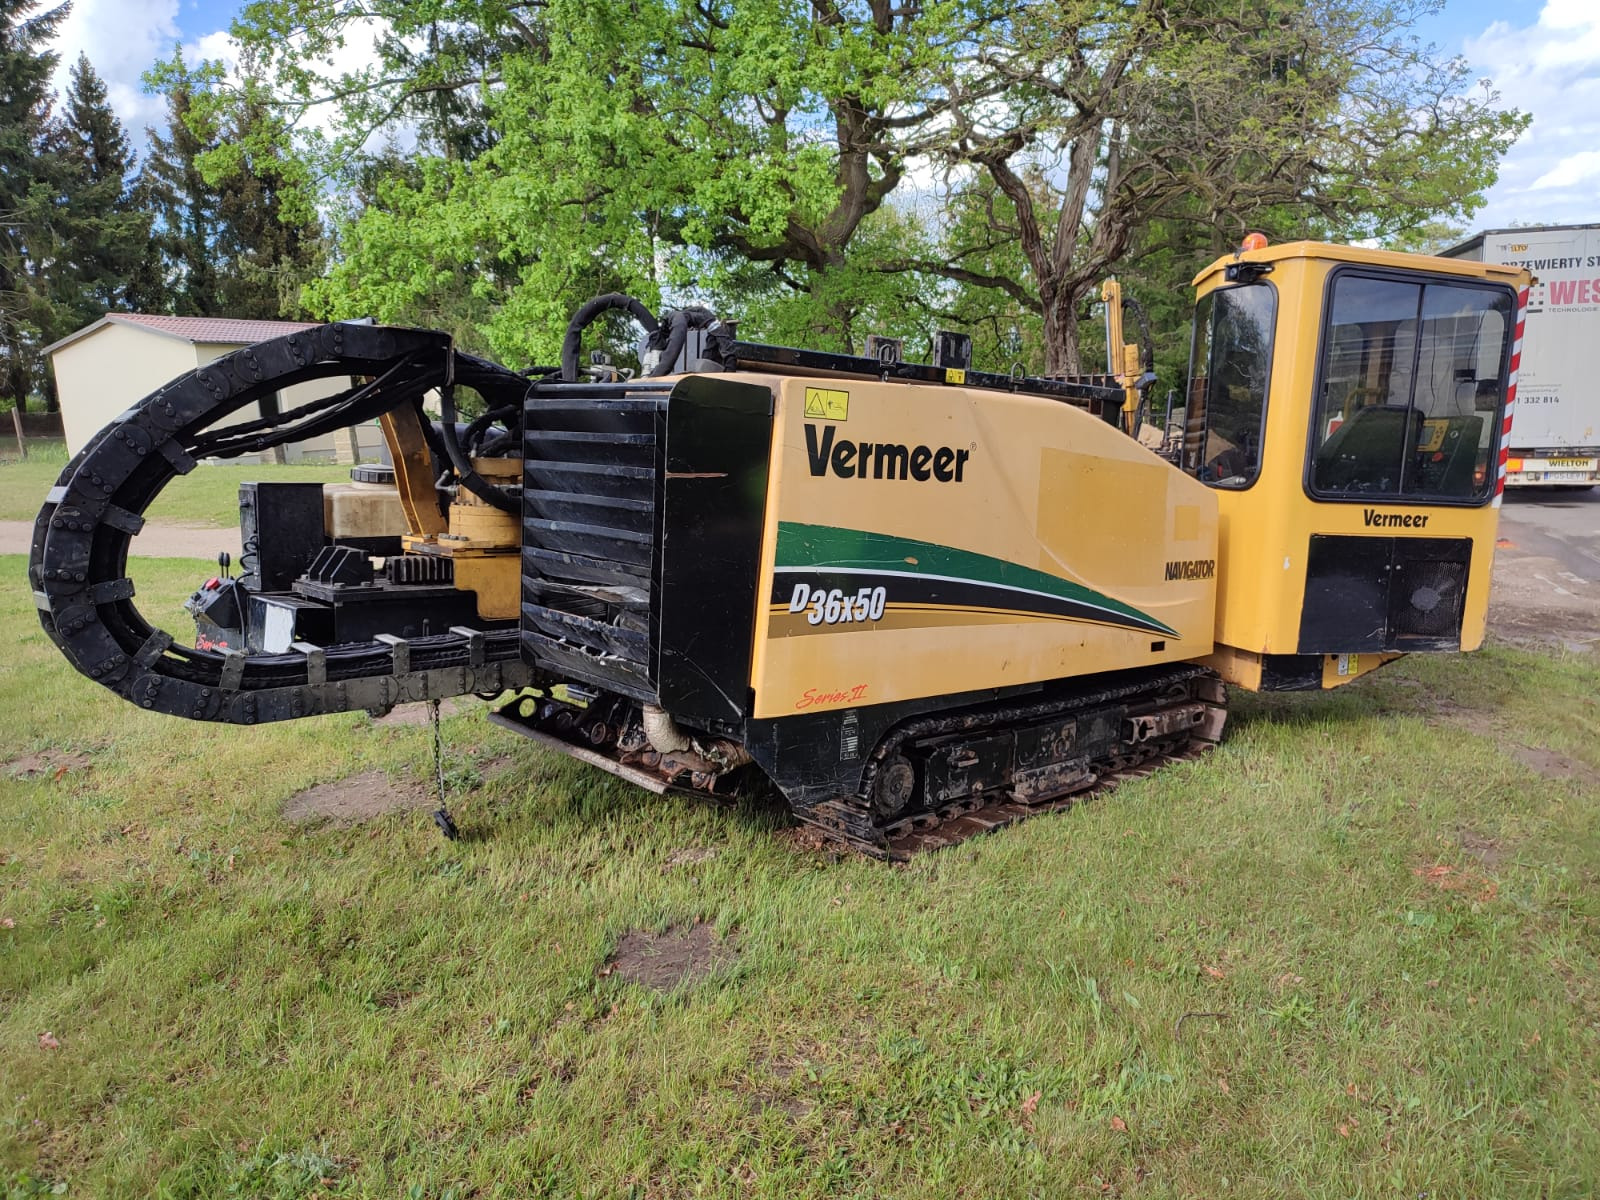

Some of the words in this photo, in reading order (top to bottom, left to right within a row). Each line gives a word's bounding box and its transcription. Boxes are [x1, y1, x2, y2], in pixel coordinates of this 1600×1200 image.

[1550, 278, 1600, 305] WES
[1523, 396, 1541, 404] 332
[1543, 396, 1560, 404] 814
[804, 424, 970, 483] Vermeer
[1548, 459, 1589, 468] WIELTON
[1363, 509, 1429, 528] Vermeer
[1165, 559, 1215, 581] NAVIGATOR
[789, 583, 888, 626] D36x50
[796, 688, 848, 709] Series
[847, 684, 868, 702] II
